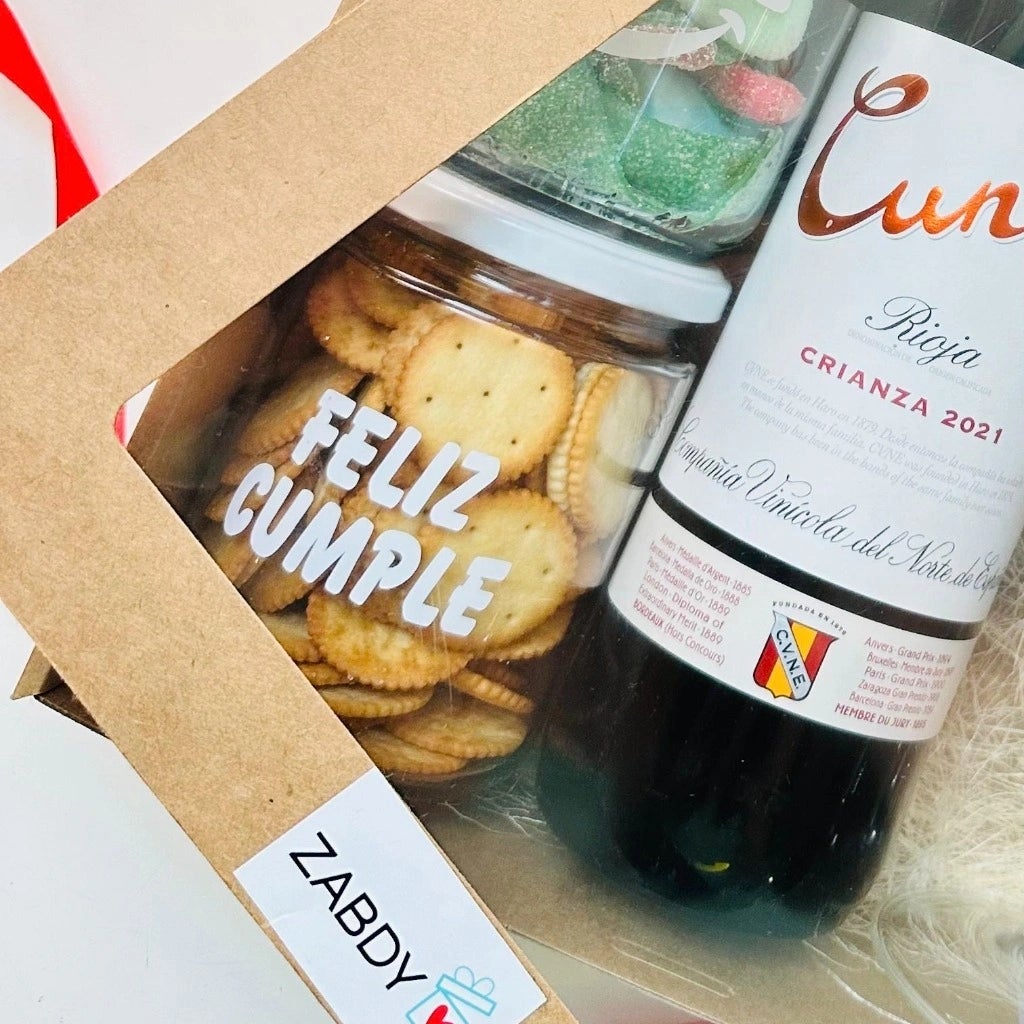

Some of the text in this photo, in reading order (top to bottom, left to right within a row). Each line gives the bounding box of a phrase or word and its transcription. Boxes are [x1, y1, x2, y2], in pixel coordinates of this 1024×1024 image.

[865, 296, 982, 369] Rioja
[800, 346, 929, 417] CRIANZA
[941, 409, 1003, 444] 2021
[291, 389, 500, 532] FELIZ
[745, 458, 855, 544] Vinícola
[843, 526, 896, 564] del
[888, 536, 955, 582] Norte
[952, 558, 979, 588] de
[224, 462, 512, 636] CUMPLE
[704, 579, 718, 594] Oro
[671, 592, 709, 623] Diploma
[712, 618, 725, 630] of
[678, 612, 698, 632] Merit
[772, 600, 815, 615] FUNDADA
[818, 612, 829, 623] EN
[633, 598, 664, 628] BORDEAUX
[684, 634, 726, 666] Concours)
[776, 630, 806, 689] C.V.N.E.
[865, 636, 894, 653] Anvers
[897, 646, 920, 660] Grand
[866, 652, 898, 669] Bruxelles
[858, 679, 892, 697] Zaragoza
[865, 666, 885, 680] Paris
[891, 674, 915, 687] Grand
[849, 691, 883, 708] Barcelona
[835, 703, 876, 723] MEMBRE
[877, 714, 889, 725] DU
[891, 716, 911, 728] JURY
[289, 831, 428, 990] ZABDY
